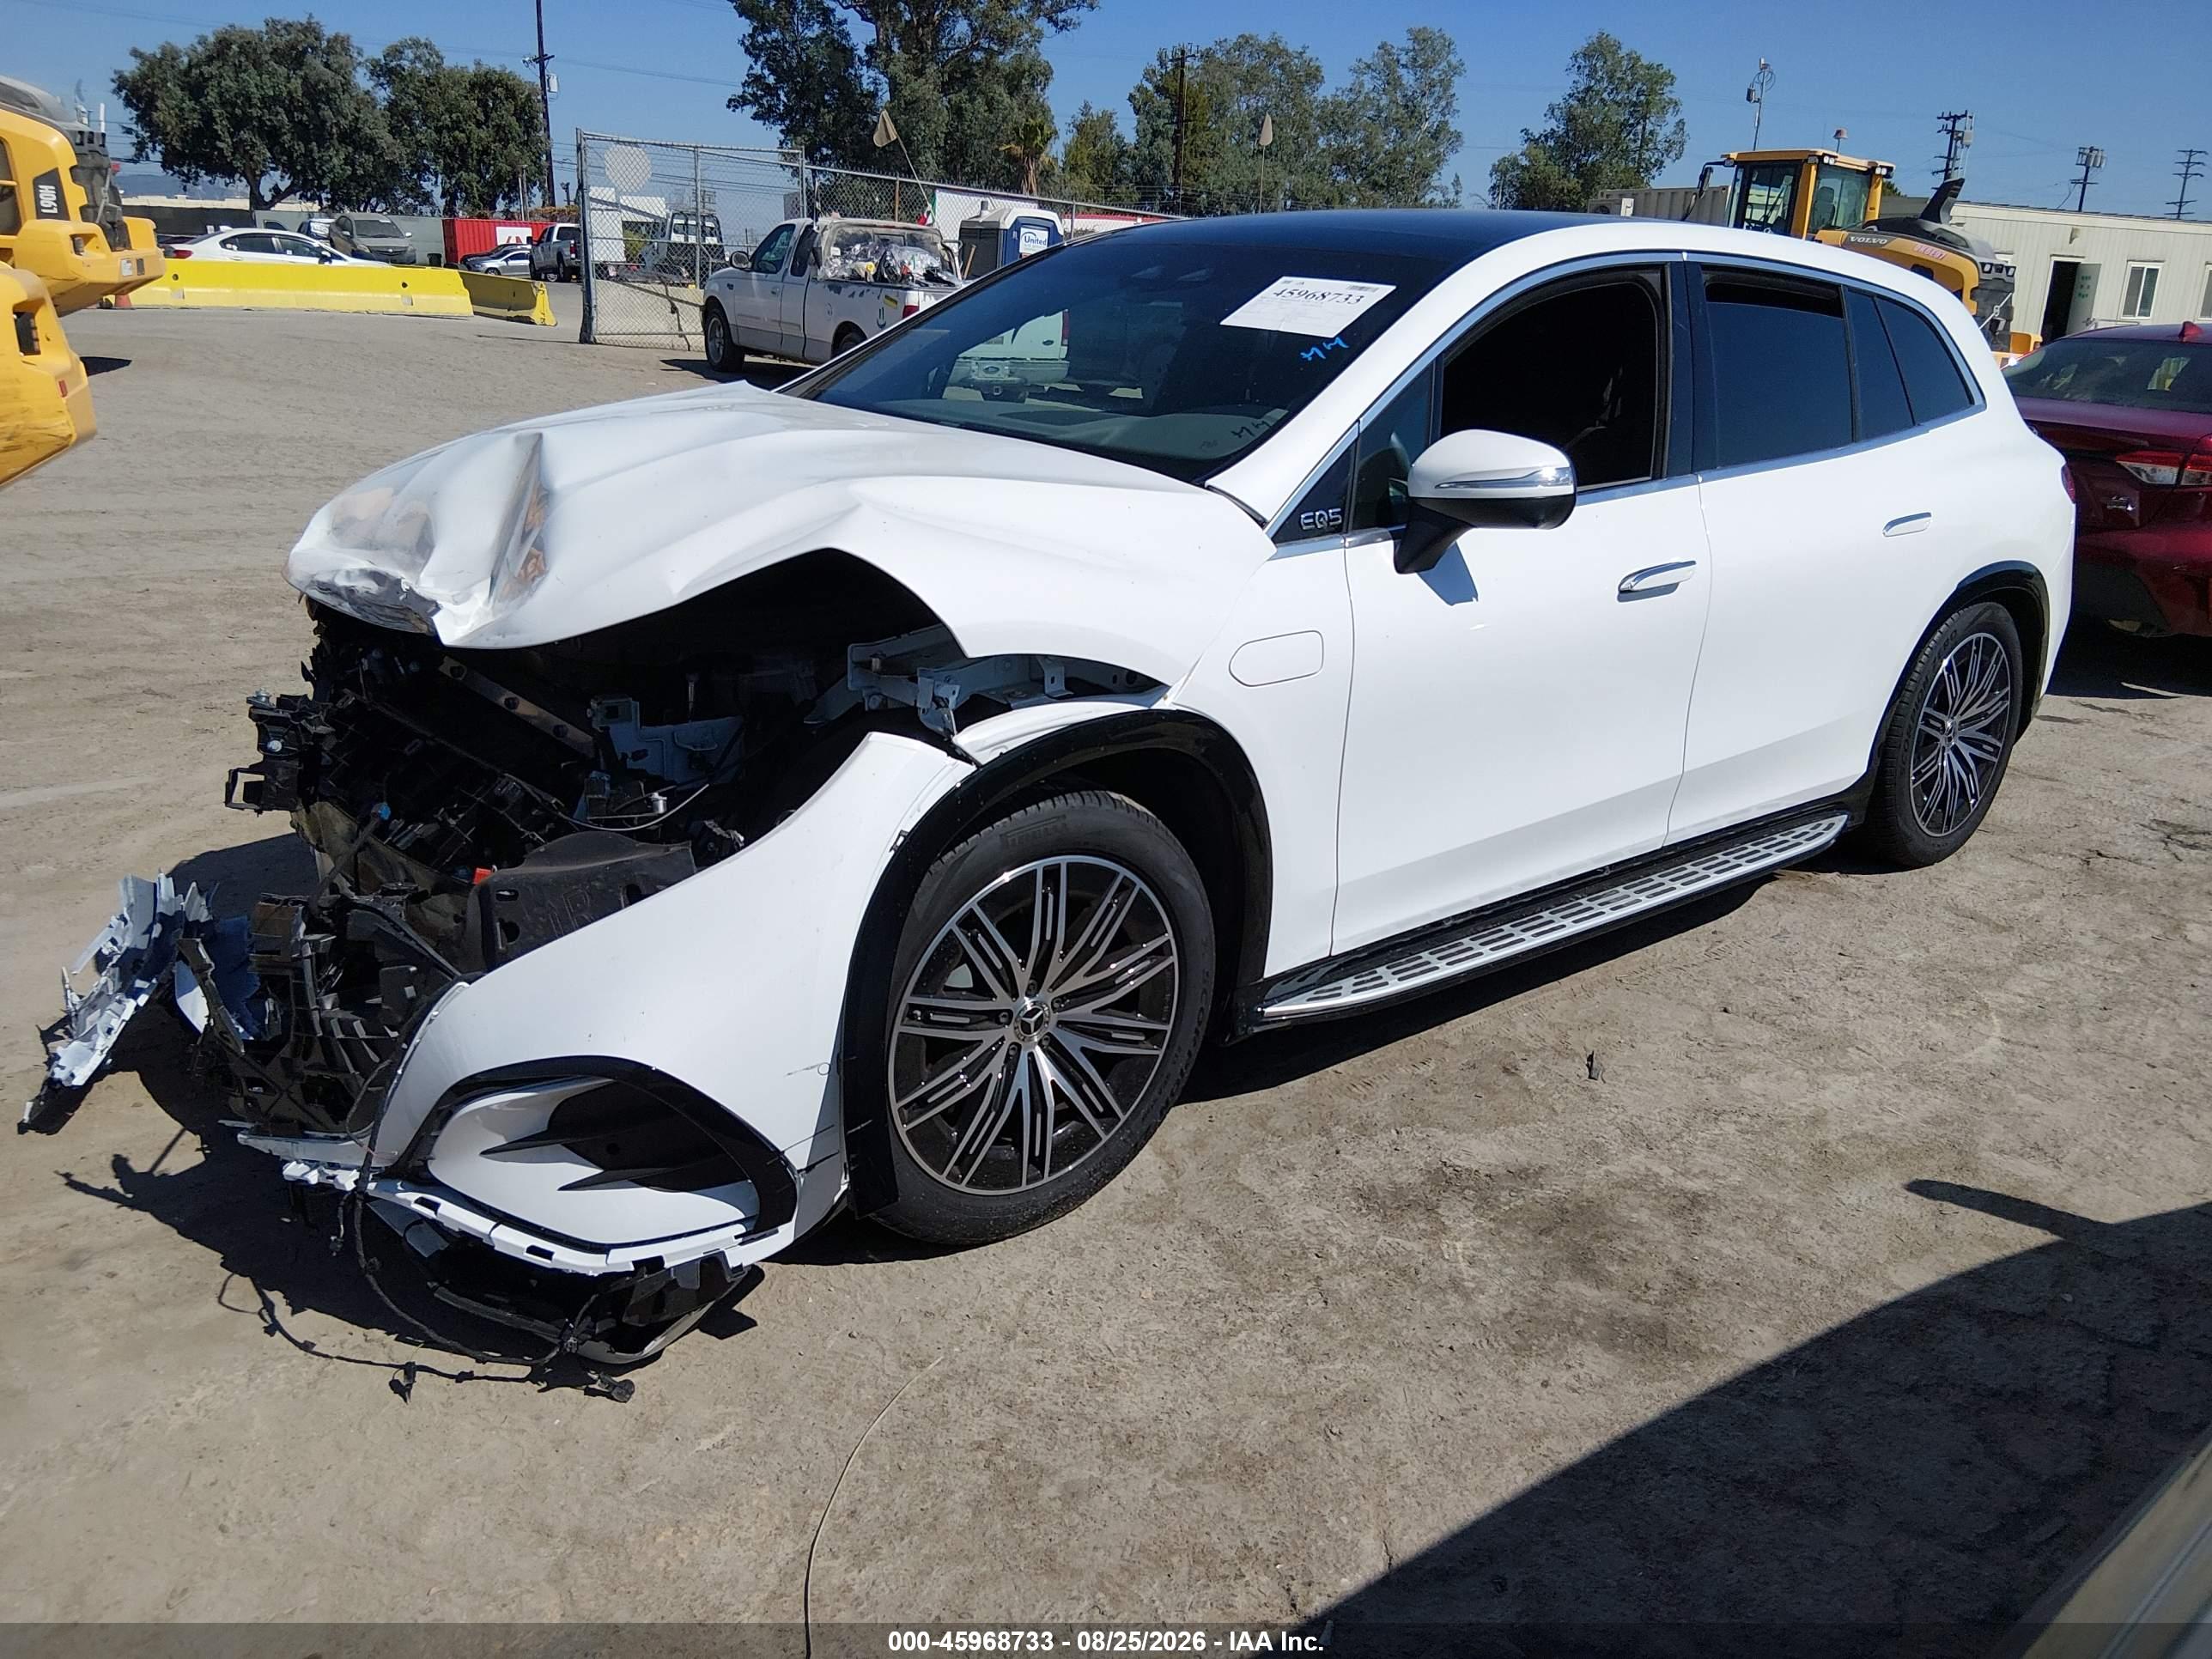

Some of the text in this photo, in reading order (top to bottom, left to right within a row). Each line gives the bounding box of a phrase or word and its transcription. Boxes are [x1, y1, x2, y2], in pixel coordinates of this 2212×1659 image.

[38, 185, 58, 213] L90H
[1024, 235, 1047, 246] United
[1850, 236, 1888, 245] VOLVO
[1273, 289, 1364, 305] 45968733
